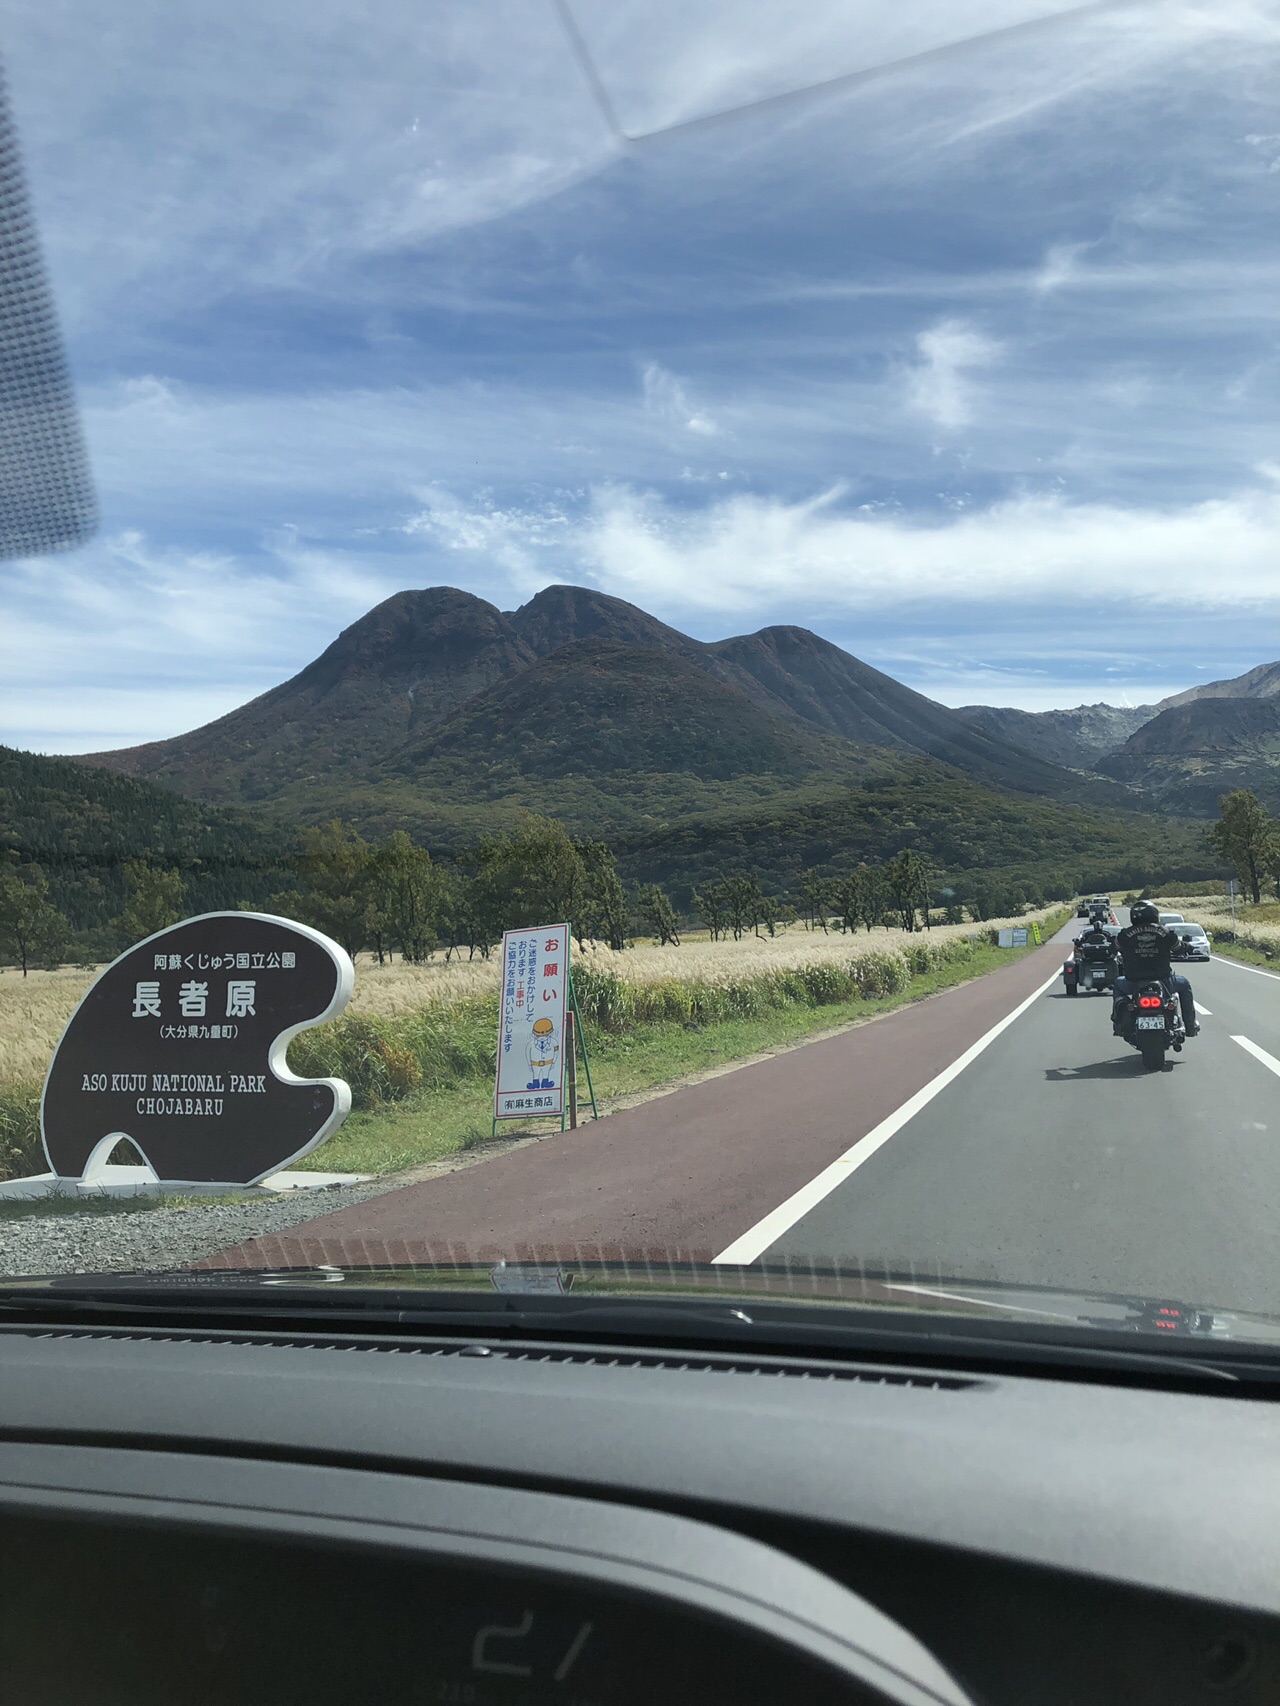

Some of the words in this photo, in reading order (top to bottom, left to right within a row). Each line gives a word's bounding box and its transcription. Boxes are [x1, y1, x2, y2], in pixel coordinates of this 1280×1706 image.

[154, 952, 297, 971] 阿蘇くじゅう国立公園
[518, 940, 528, 977] おります
[542, 938, 560, 1002] お願い
[131, 979, 257, 1018] 長者原
[503, 941, 517, 1053] ご協力をお願いいたします
[515, 981, 525, 1008] 工事中
[81, 1074, 108, 1092] ASO
[110, 1074, 147, 1092] KUJU
[152, 1074, 225, 1093] NATIONAL
[229, 1075, 267, 1093] PARK
[136, 1098, 224, 1116] CHOJABARU
